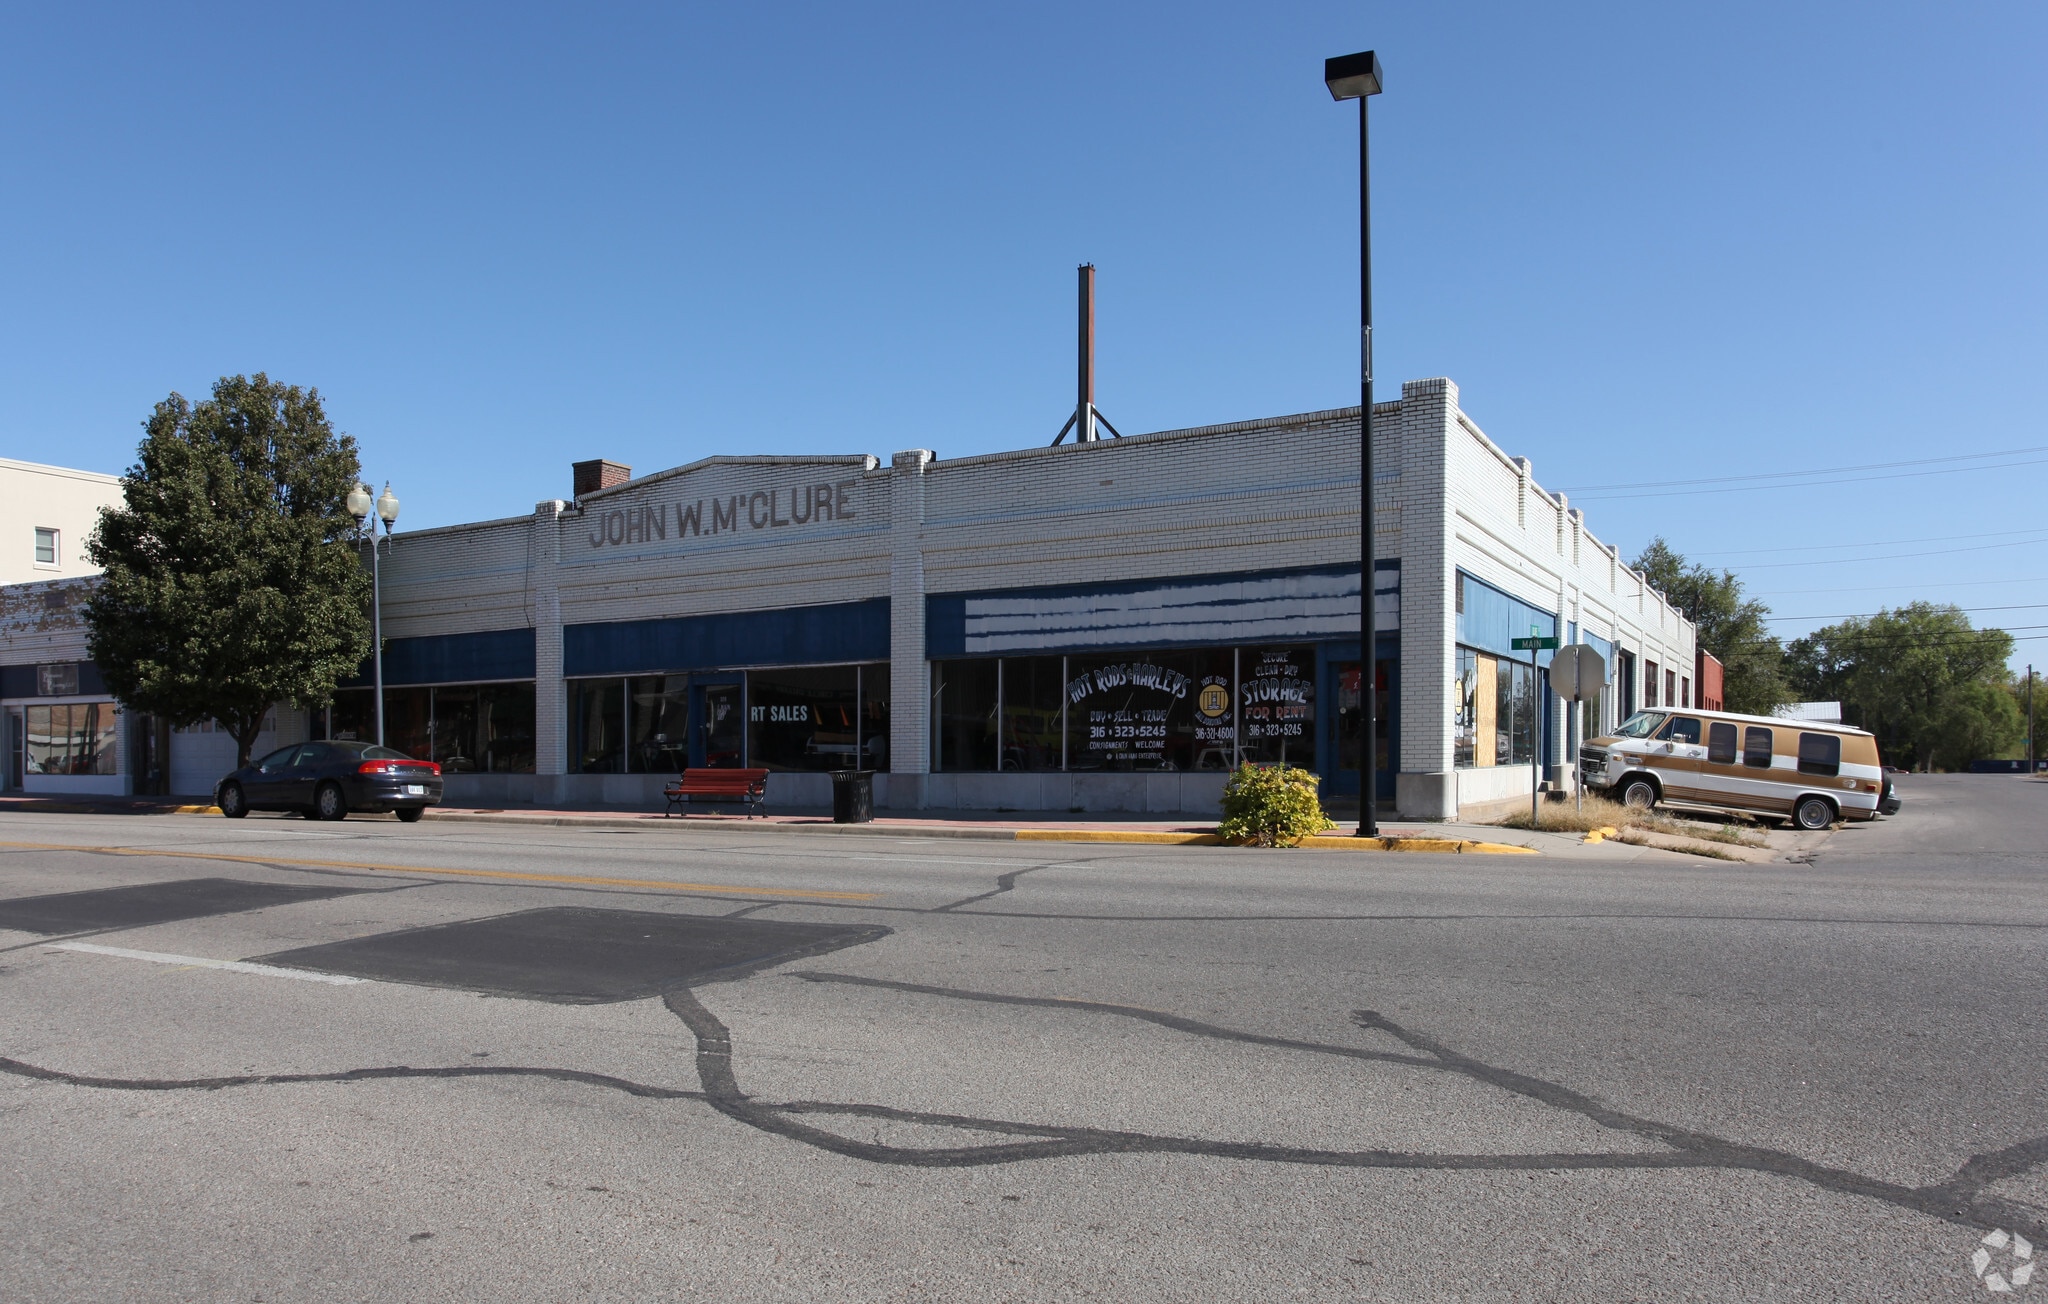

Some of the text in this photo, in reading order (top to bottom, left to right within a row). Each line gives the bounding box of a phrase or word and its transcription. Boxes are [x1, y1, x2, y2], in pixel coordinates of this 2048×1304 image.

[588, 504, 666, 548] JOHN
[1522, 640, 1541, 649] MAIN
[1255, 664, 1299, 677] CLEAN DRY
[1066, 673, 1094, 704] HOT
[1094, 663, 1127, 692] RODS
[1132, 662, 1191, 699] HARLEYS
[1200, 675, 1228, 687] HOT ROD
[1240, 677, 1311, 706] STORAGE
[750, 705, 808, 721] RT SALES
[1089, 709, 1167, 723] BUY SELL TRADE
[1245, 706, 1271, 722] FOR
[1275, 705, 1307, 721] RENT
[1135, 740, 1165, 749] WELCOME
